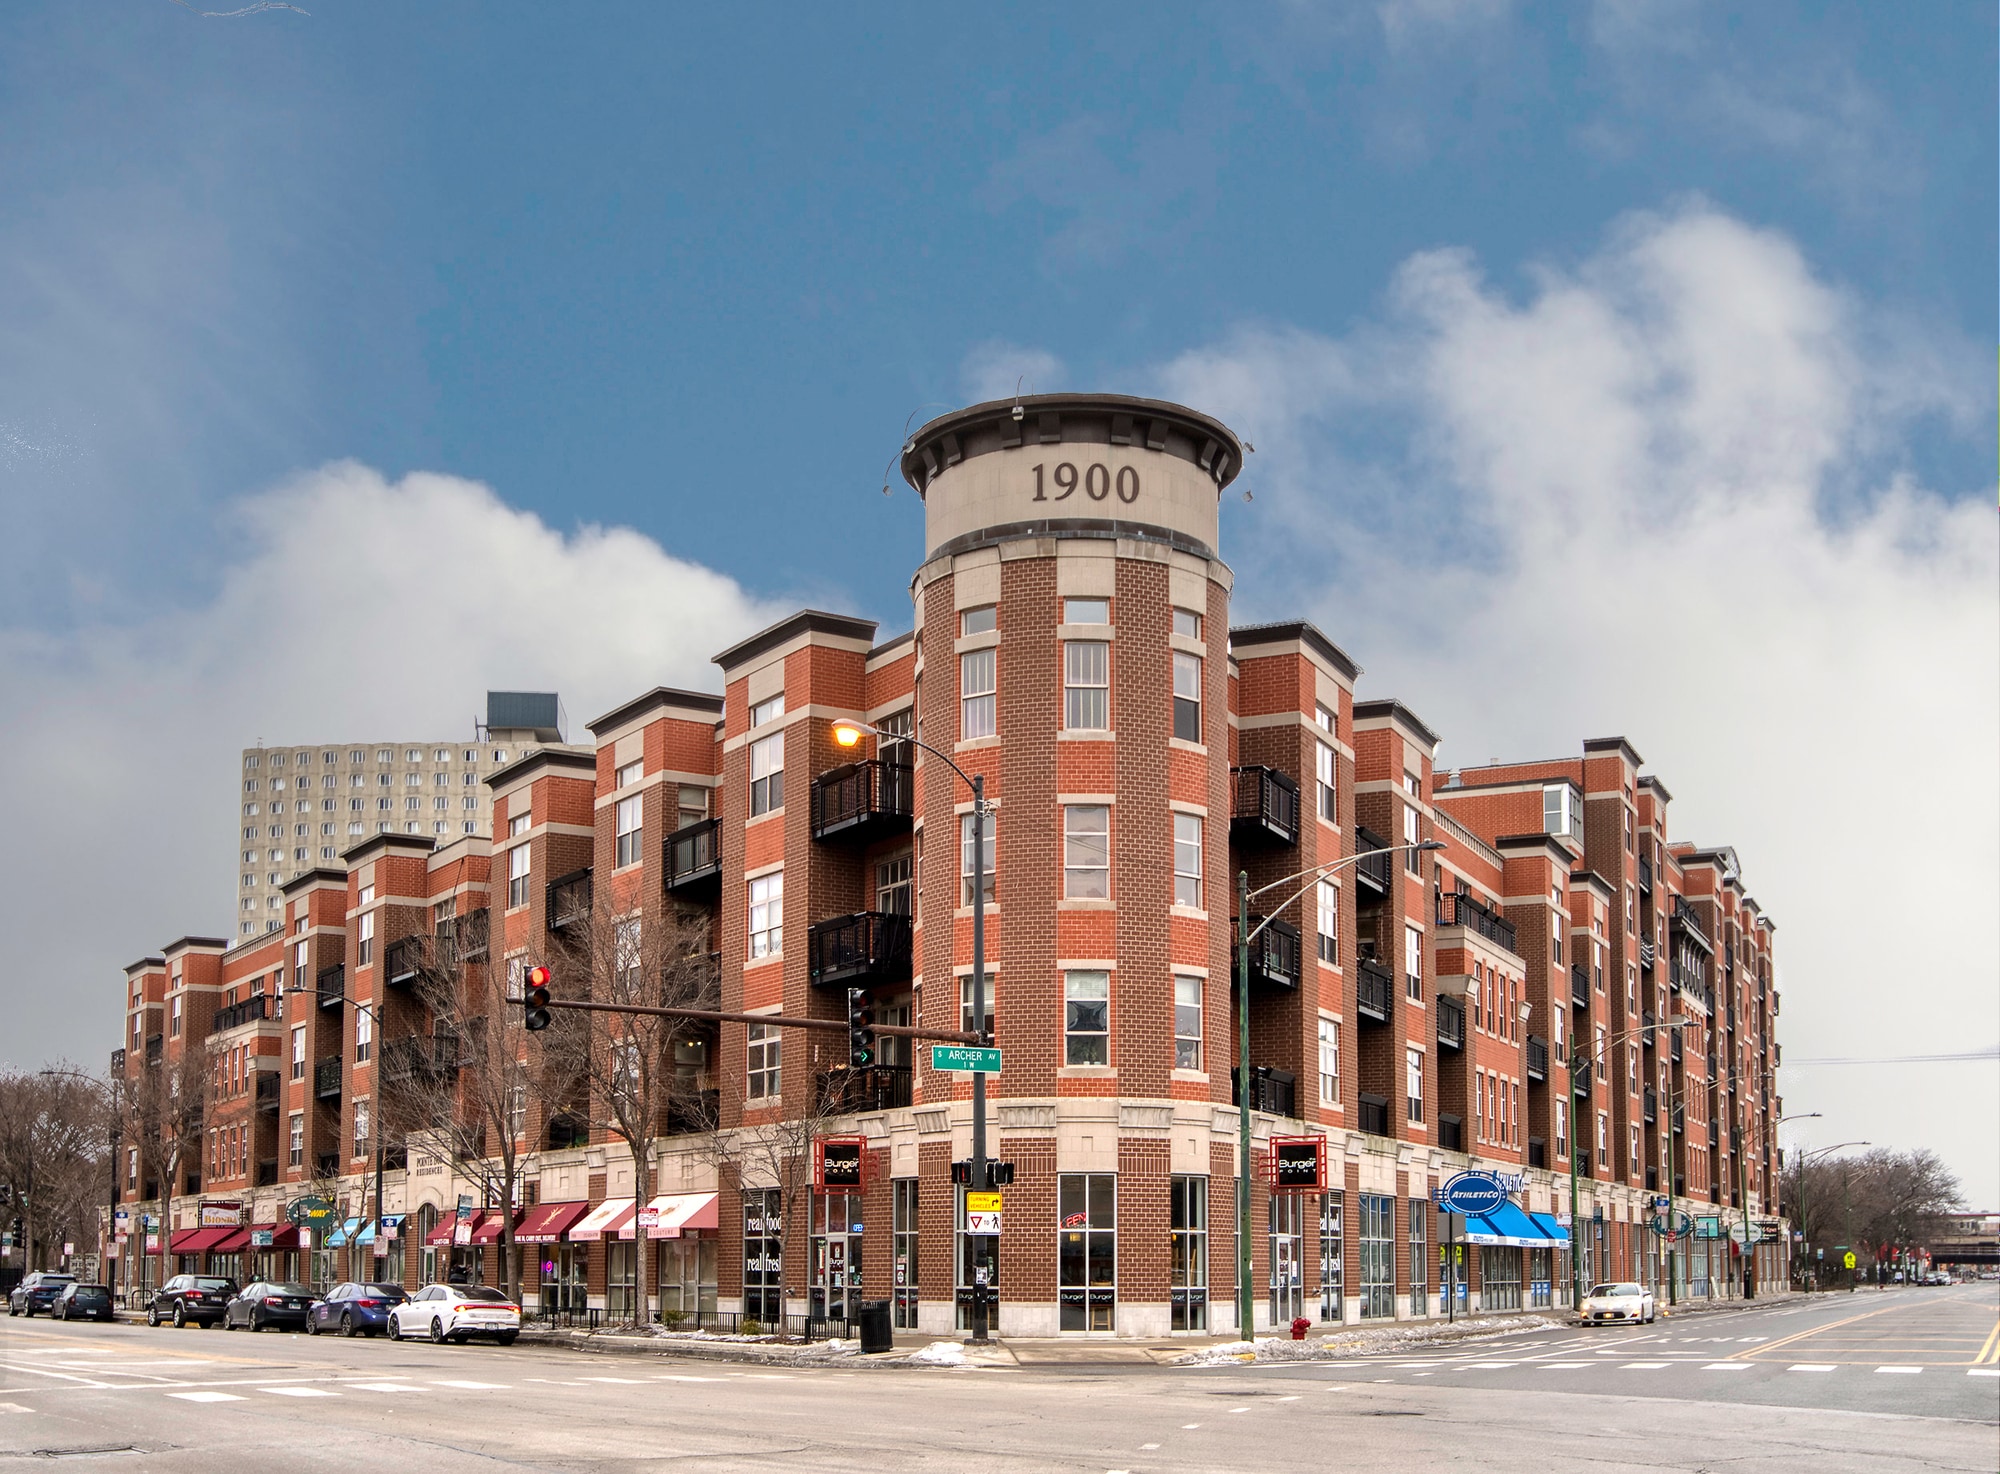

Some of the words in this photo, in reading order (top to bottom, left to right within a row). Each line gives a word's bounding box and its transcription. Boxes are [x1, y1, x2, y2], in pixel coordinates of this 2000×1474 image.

[1032, 462, 1140, 504] 1900
[937, 1050, 943, 1058] S
[948, 1050, 982, 1061] ARCHER
[824, 1158, 859, 1169] Burger
[1278, 1159, 1317, 1170] Burger
[747, 1212, 764, 1231] real
[747, 1253, 764, 1272] real
